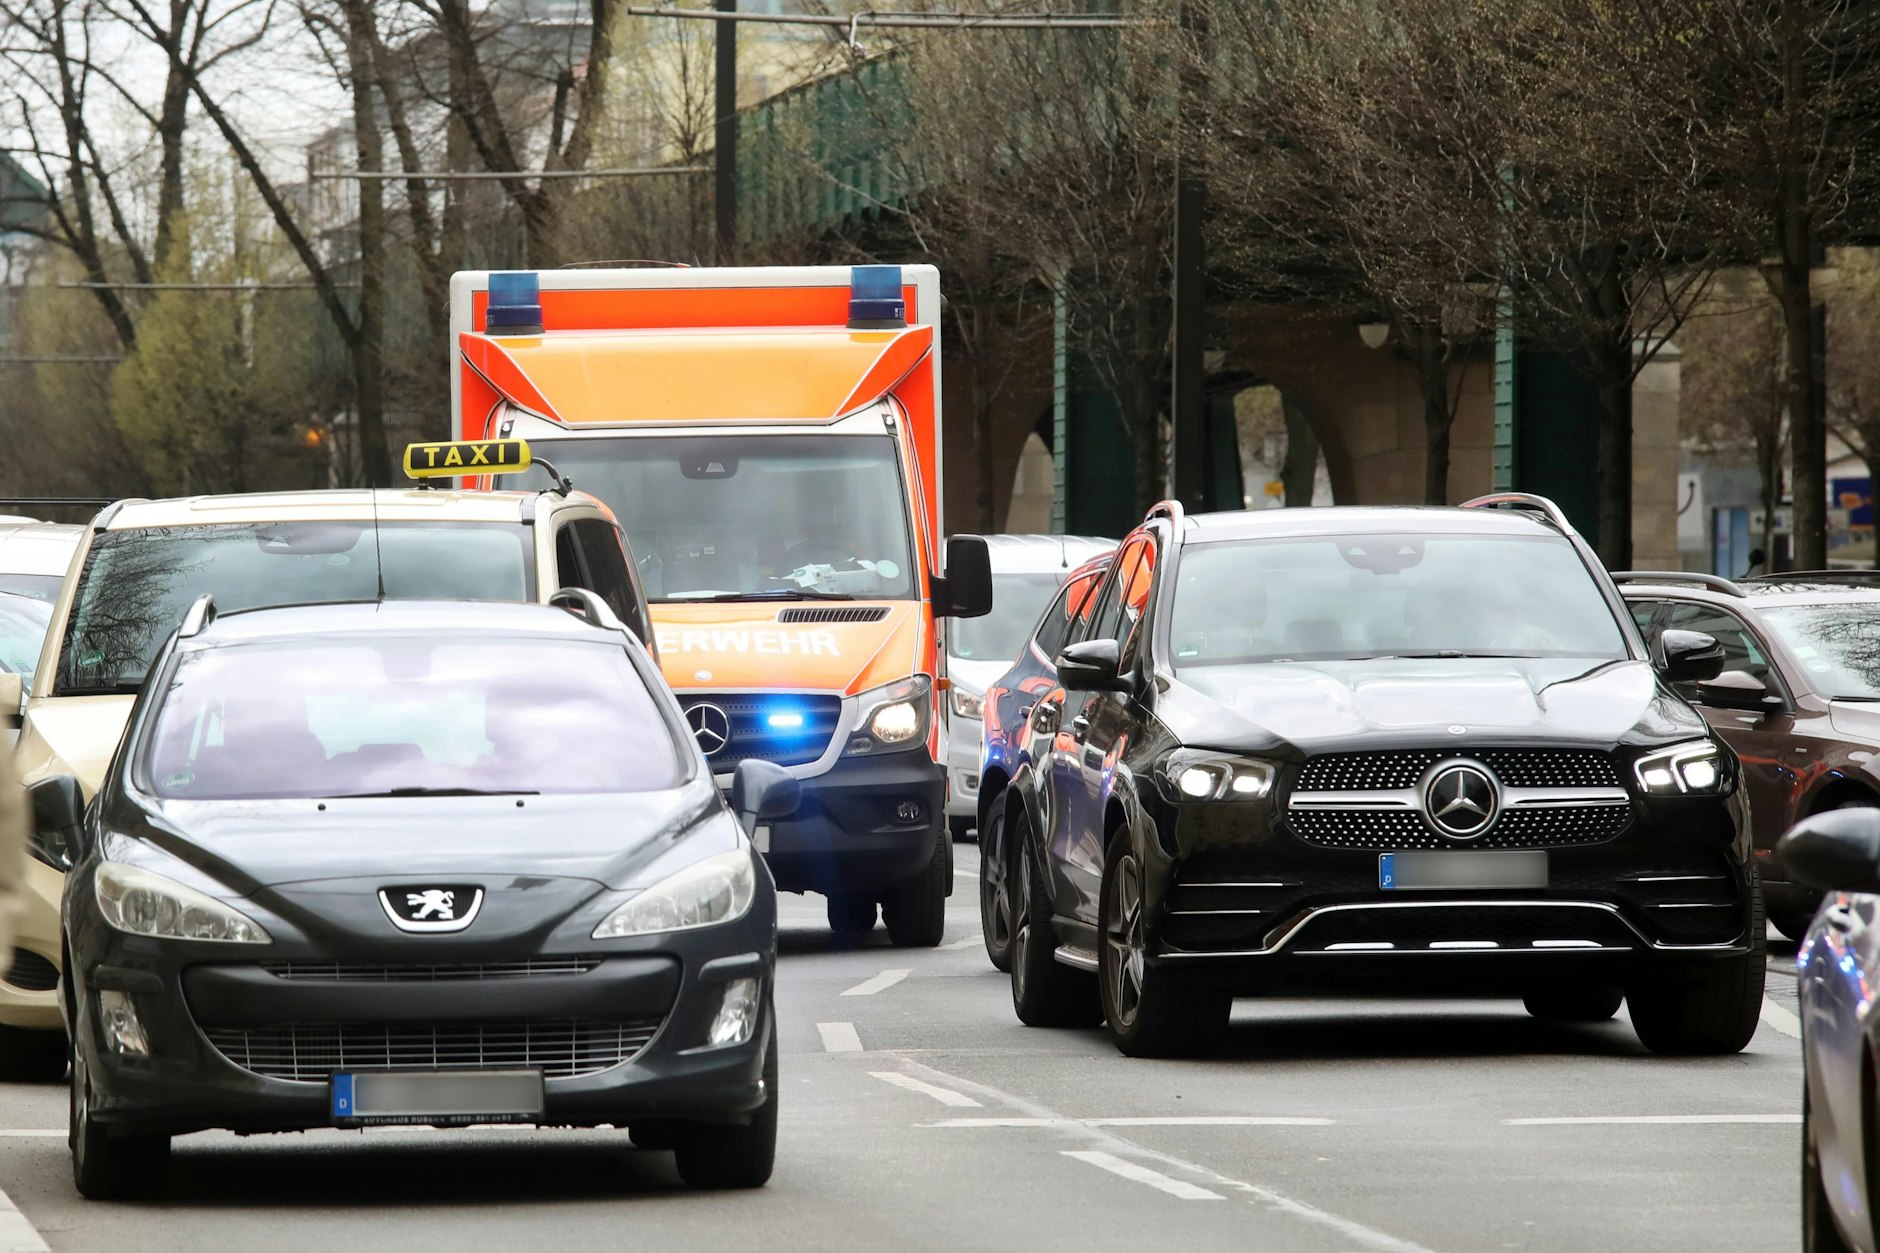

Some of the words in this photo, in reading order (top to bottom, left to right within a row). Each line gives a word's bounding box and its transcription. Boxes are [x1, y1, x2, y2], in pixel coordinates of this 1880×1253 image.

[423, 444, 505, 467] TAXI
[1385, 875, 1392, 883] D
[339, 1098, 347, 1109] D
